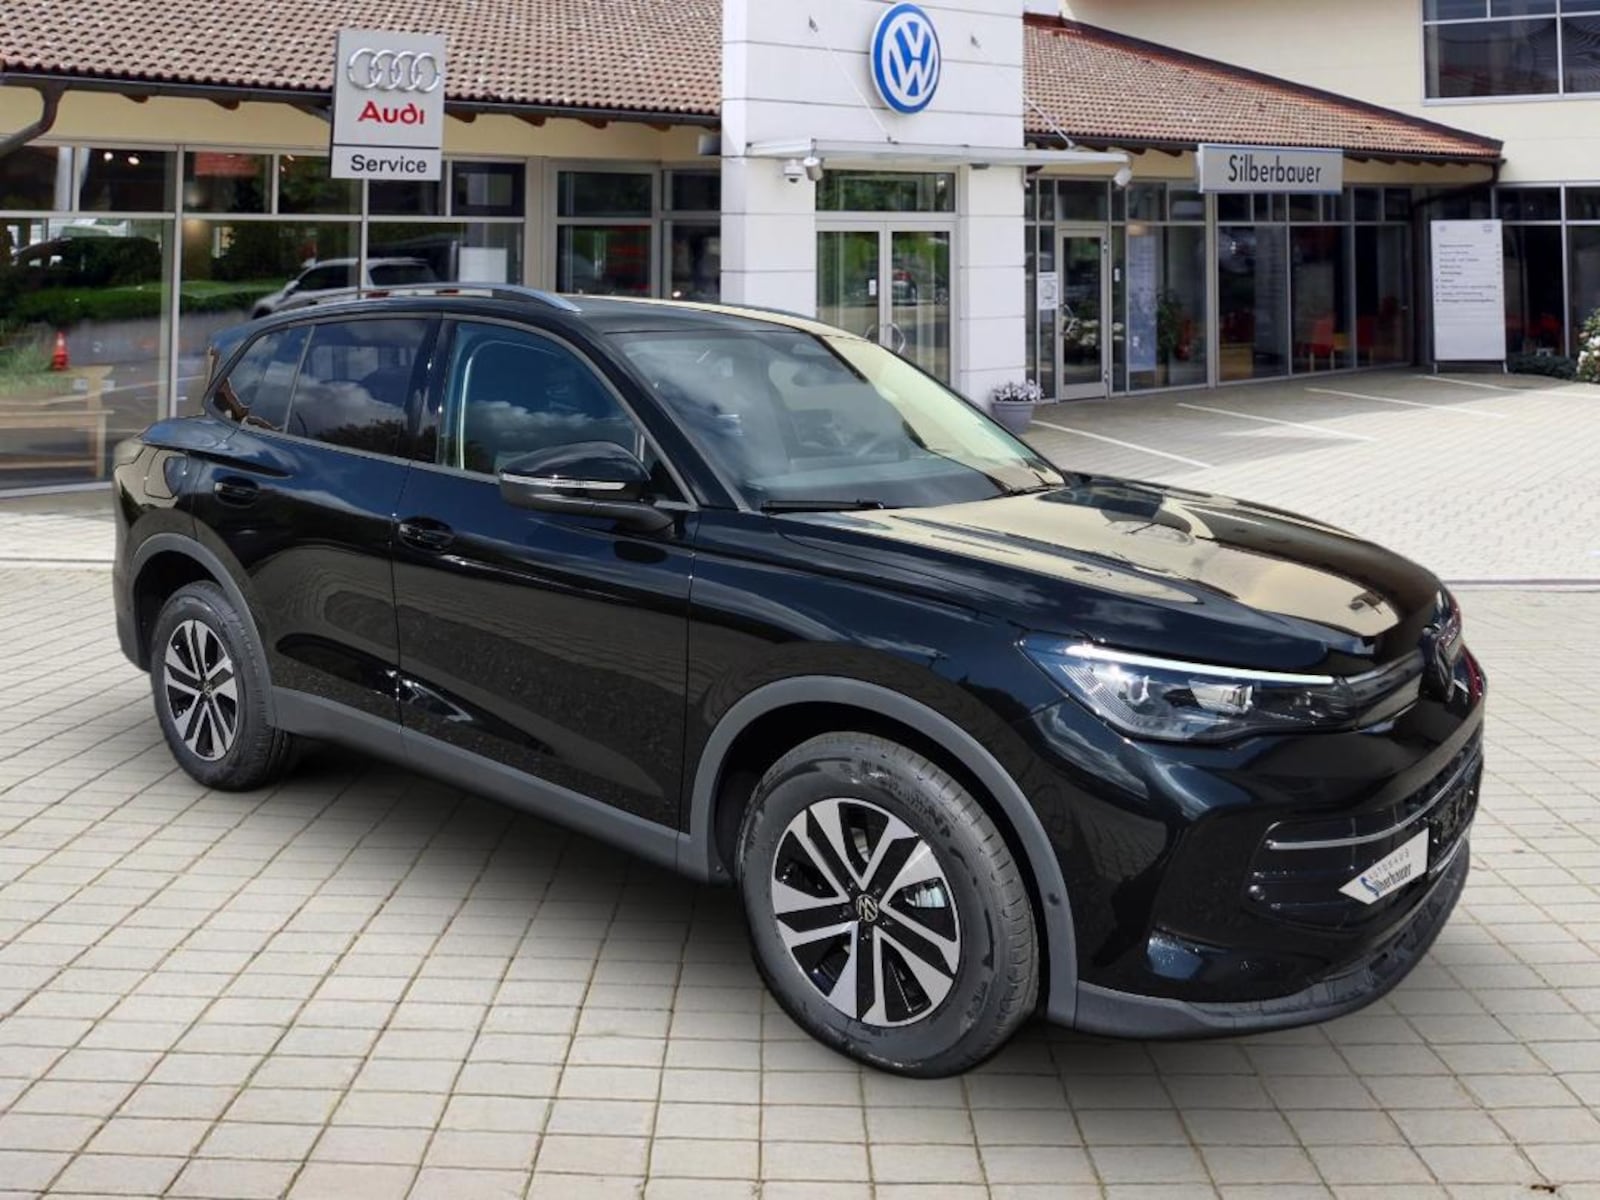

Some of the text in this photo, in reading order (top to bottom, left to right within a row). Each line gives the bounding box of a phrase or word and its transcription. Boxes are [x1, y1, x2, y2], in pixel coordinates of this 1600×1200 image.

[881, 13, 938, 106] VW
[357, 101, 424, 125] Audi
[350, 154, 427, 173] Service
[1228, 154, 1321, 183] Silberbauer
